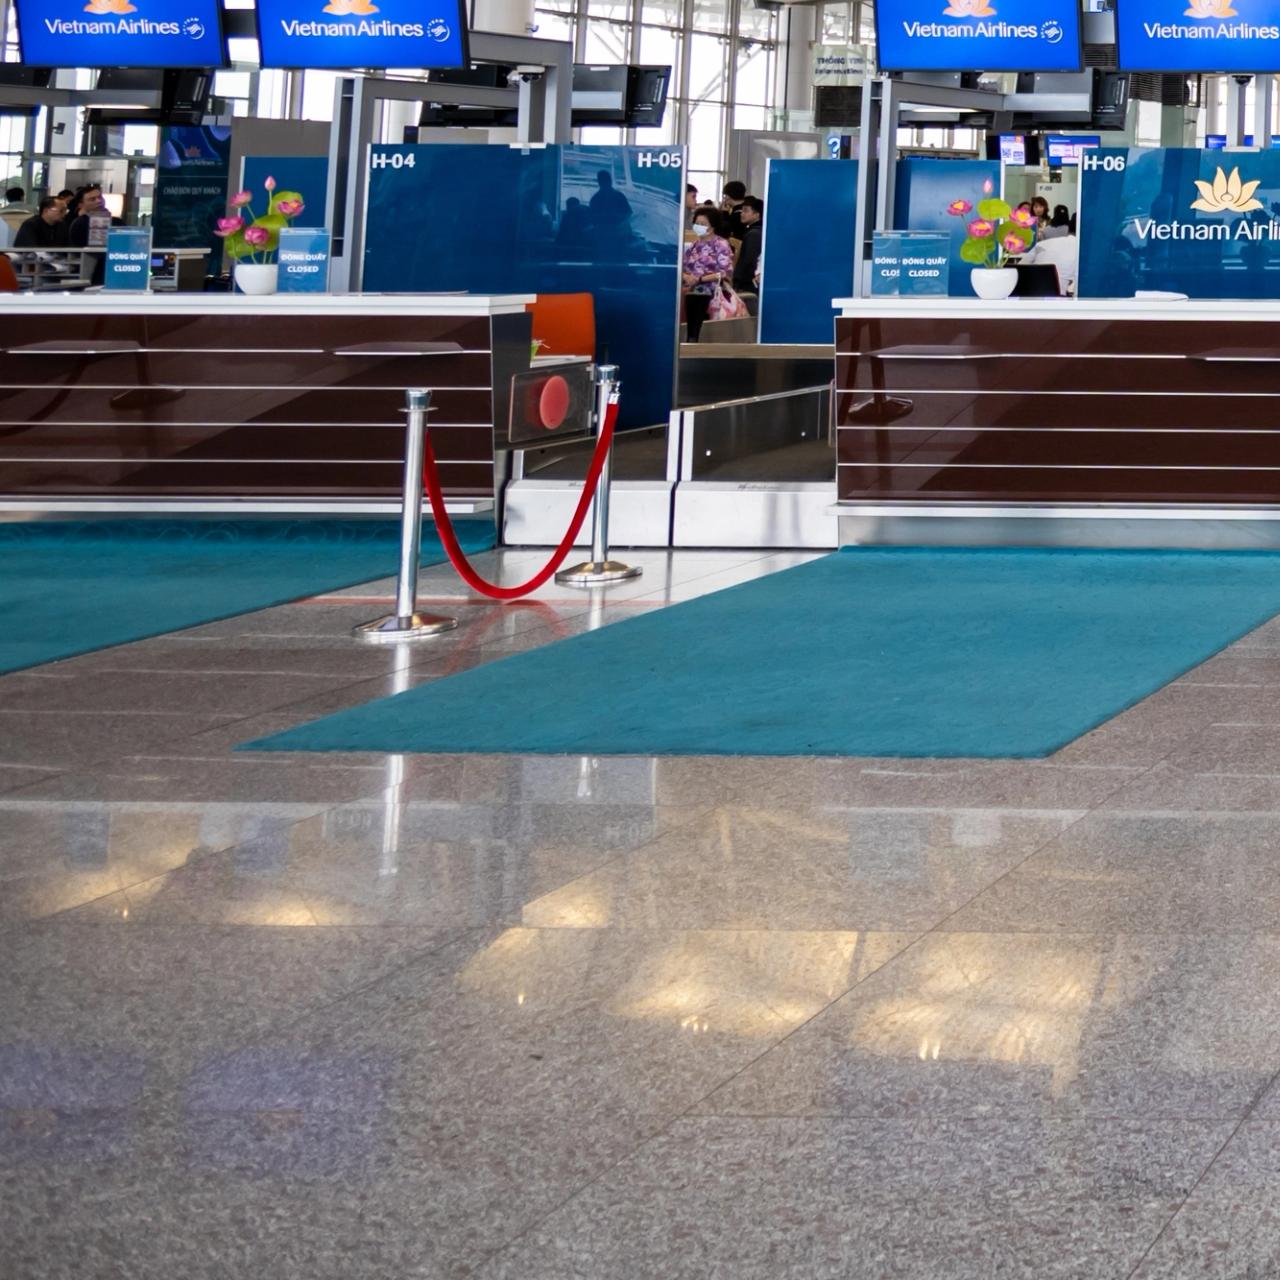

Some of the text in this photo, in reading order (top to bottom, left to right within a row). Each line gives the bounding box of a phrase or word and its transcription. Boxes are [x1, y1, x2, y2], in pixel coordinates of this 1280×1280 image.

[45, 18, 115, 35] Vietnam
[117, 18, 180, 35] Airlines
[281, 19, 357, 37] Vietnam
[357, 20, 424, 37] Airlines
[903, 21, 974, 38] Vietnam
[975, 21, 1038, 38] Airlines
[1143, 22, 1215, 39] Vietnam
[1216, 22, 1280, 39] Airlines
[371, 153, 416, 169] H-04
[637, 152, 682, 168] H-05
[1083, 155, 1125, 172] H-06
[1133, 218, 1230, 241] Vietnam
[287, 265, 319, 273] CLOSED
[908, 269, 940, 277] CLOSED
